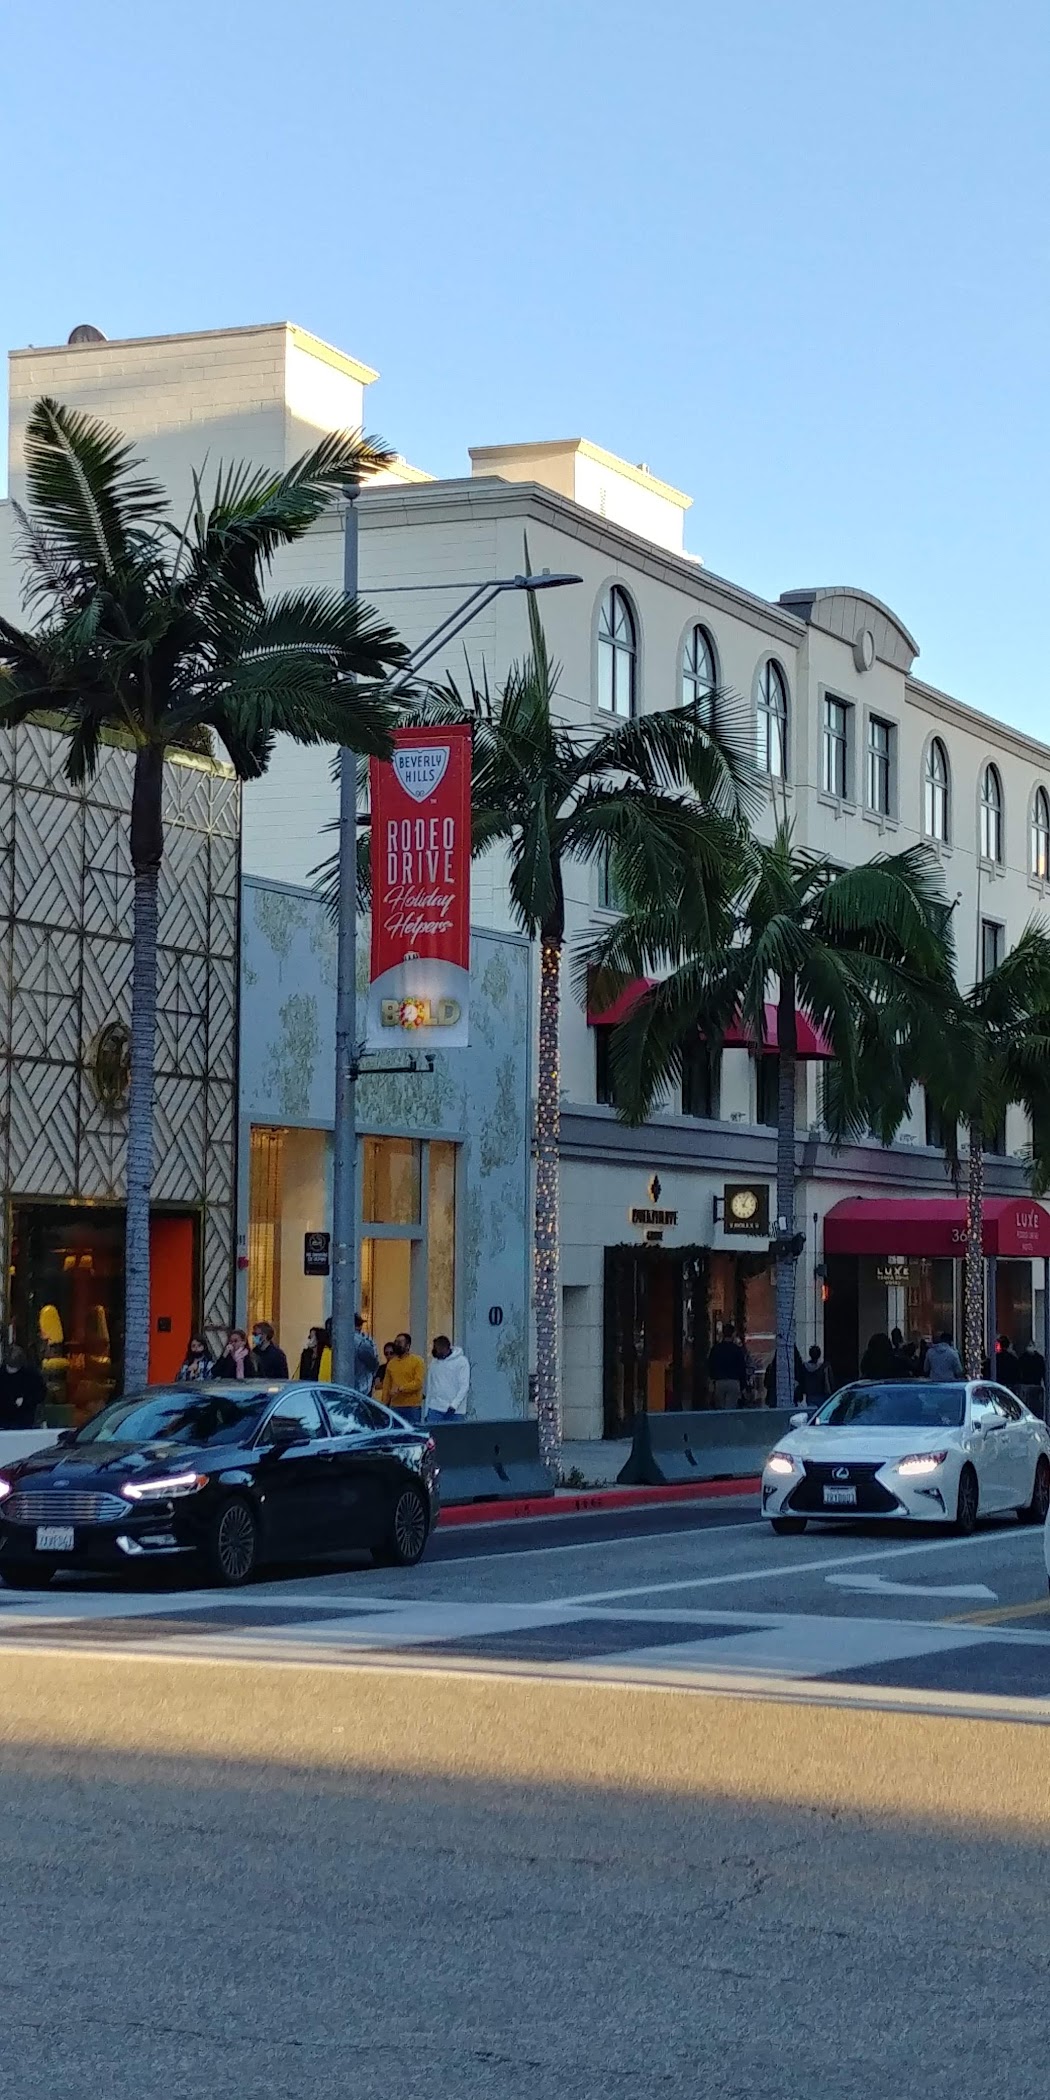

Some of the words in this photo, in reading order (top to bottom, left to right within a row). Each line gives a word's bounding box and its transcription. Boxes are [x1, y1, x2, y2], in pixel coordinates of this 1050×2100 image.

[399, 755, 442, 769] BEVERLY
[405, 769, 435, 782] HILLS
[387, 817, 454, 852] RODEO
[387, 850, 455, 885] DRIVE
[383, 885, 456, 918] Holiday
[383, 911, 454, 945] Helpers
[1016, 1208, 1039, 1229] LUXE
[877, 1265, 910, 1275] LUXE
